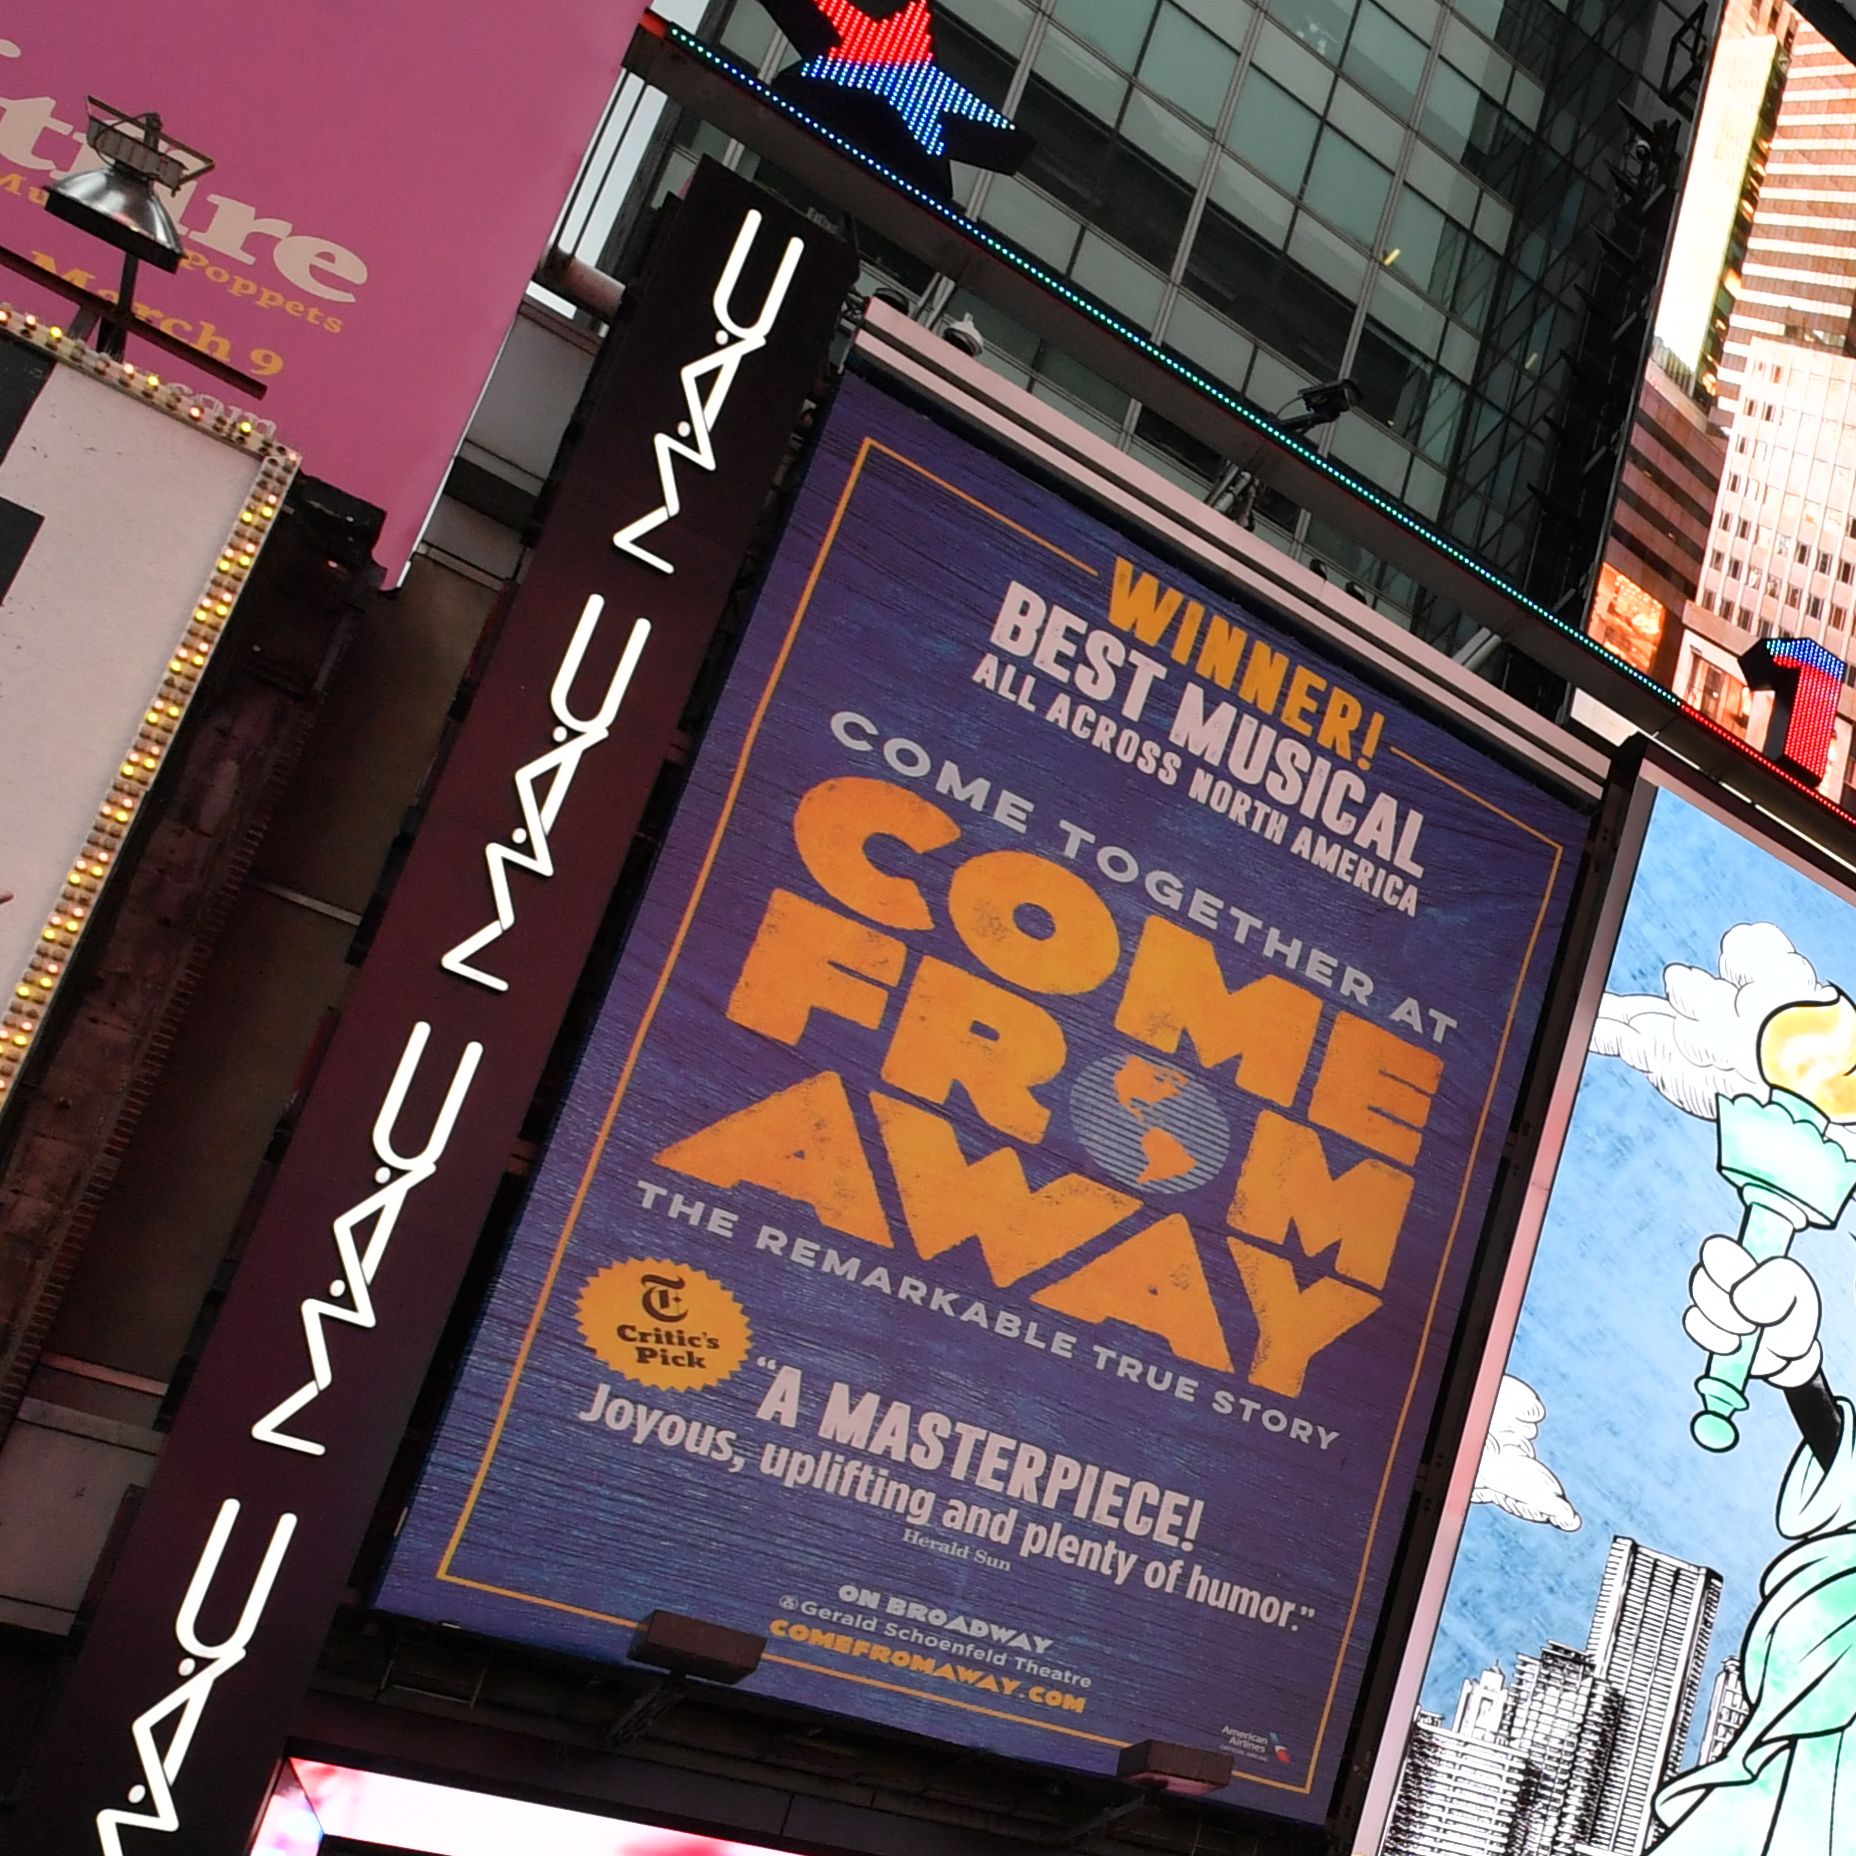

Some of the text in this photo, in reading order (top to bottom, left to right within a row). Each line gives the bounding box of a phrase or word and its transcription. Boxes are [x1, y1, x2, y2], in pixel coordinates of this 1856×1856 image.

[180, 248, 342, 334] Poppets
[249, 347, 284, 376] 9
[1108, 556, 1386, 771] WINNER!
[990, 580, 1426, 878] BEST MUSICAL
[972, 652, 1419, 918] ALL ACROSS NORTH AMERICA
[830, 710, 1460, 1043] COME TOGETHER AT
[793, 775, 1444, 1167] COME
[651, 1069, 1384, 1399] AWAY
[616, 1323, 721, 1351] Critic's
[635, 1346, 707, 1371] Pick
[636, 1179, 1343, 1453] THE REMARKABLE TRUE STORY
[578, 1383, 746, 1475] Joyous,
[760, 1439, 936, 1527] uplifting
[942, 1494, 1012, 1546] and
[1021, 1515, 1137, 1593] plenty
[1144, 1553, 1185, 1598] of
[819, 1392, 1204, 1553] MASTERPIECE!
[902, 1527, 1012, 1573] Herald Sun
[769, 1618, 1088, 1714] COMEFROMAWAY.COM
[800, 1599, 1093, 1689] Gerald Schoenfeld Theatre
[838, 1584, 1054, 1655] ON BROADWAY
[1221, 1724, 1269, 1747] American
[1227, 1736, 1266, 1754] Airlines
